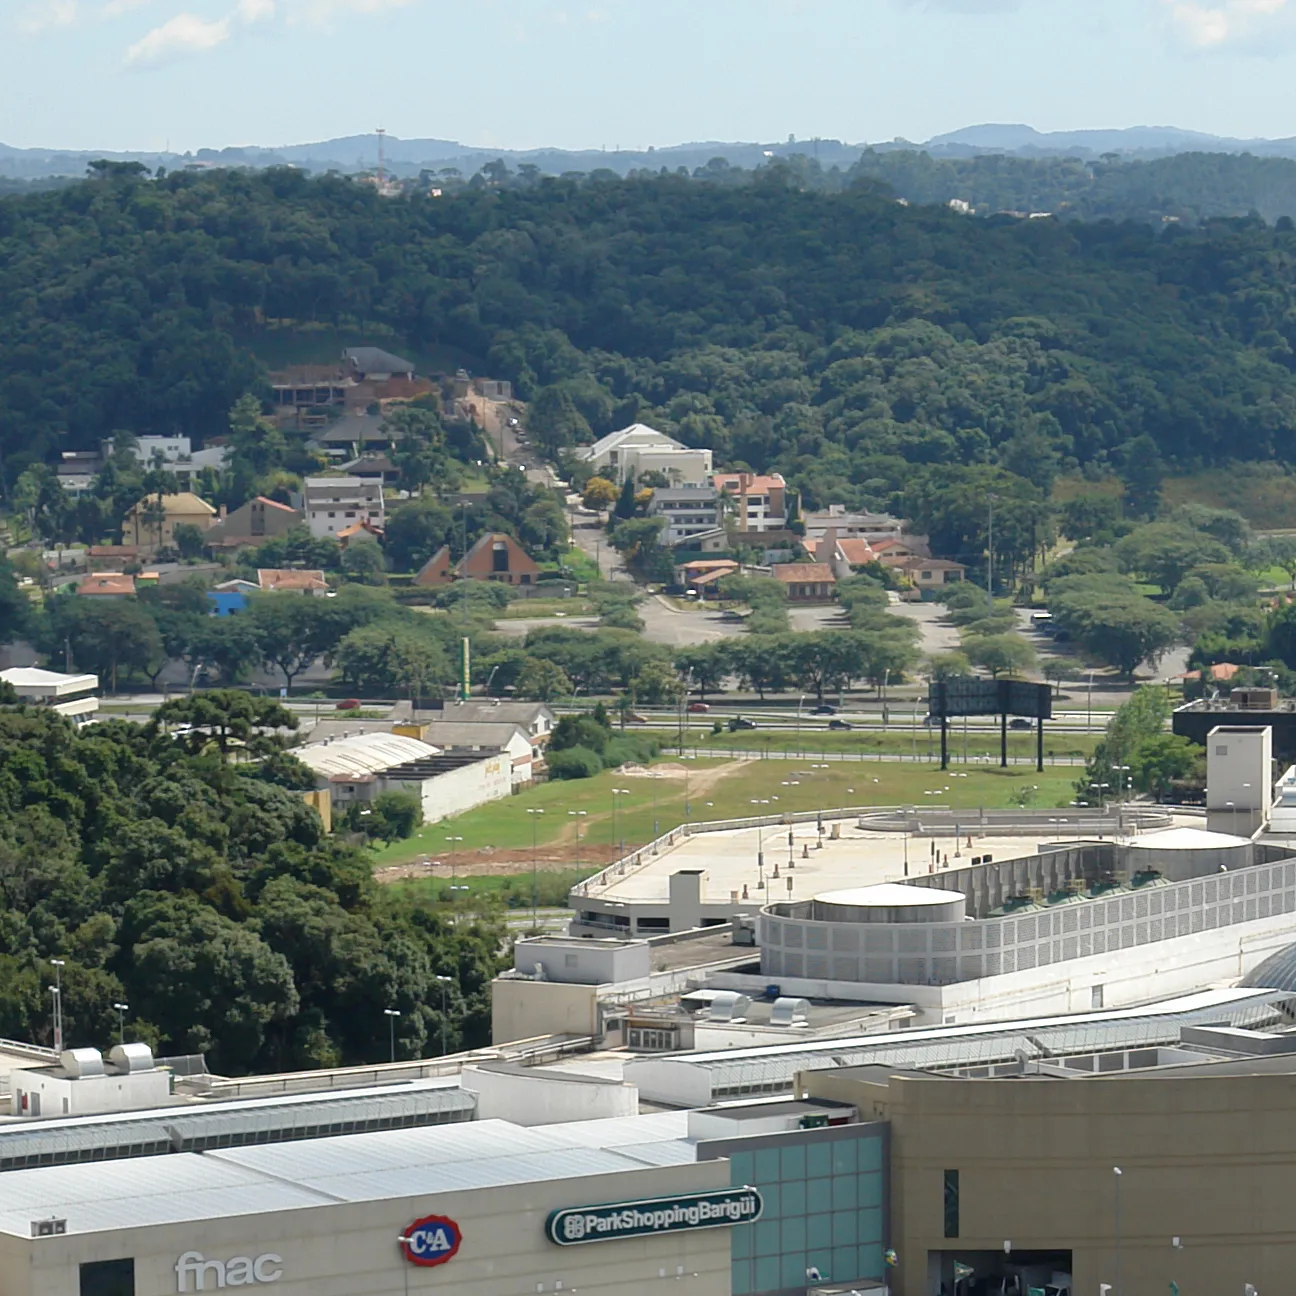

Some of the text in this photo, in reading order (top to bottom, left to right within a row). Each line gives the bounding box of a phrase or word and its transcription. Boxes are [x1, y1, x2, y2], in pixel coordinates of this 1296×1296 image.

[585, 1196, 756, 1234] ParkShoppingBarigüi
[410, 1228, 452, 1254] C&A
[175, 1251, 283, 1293] fnac
